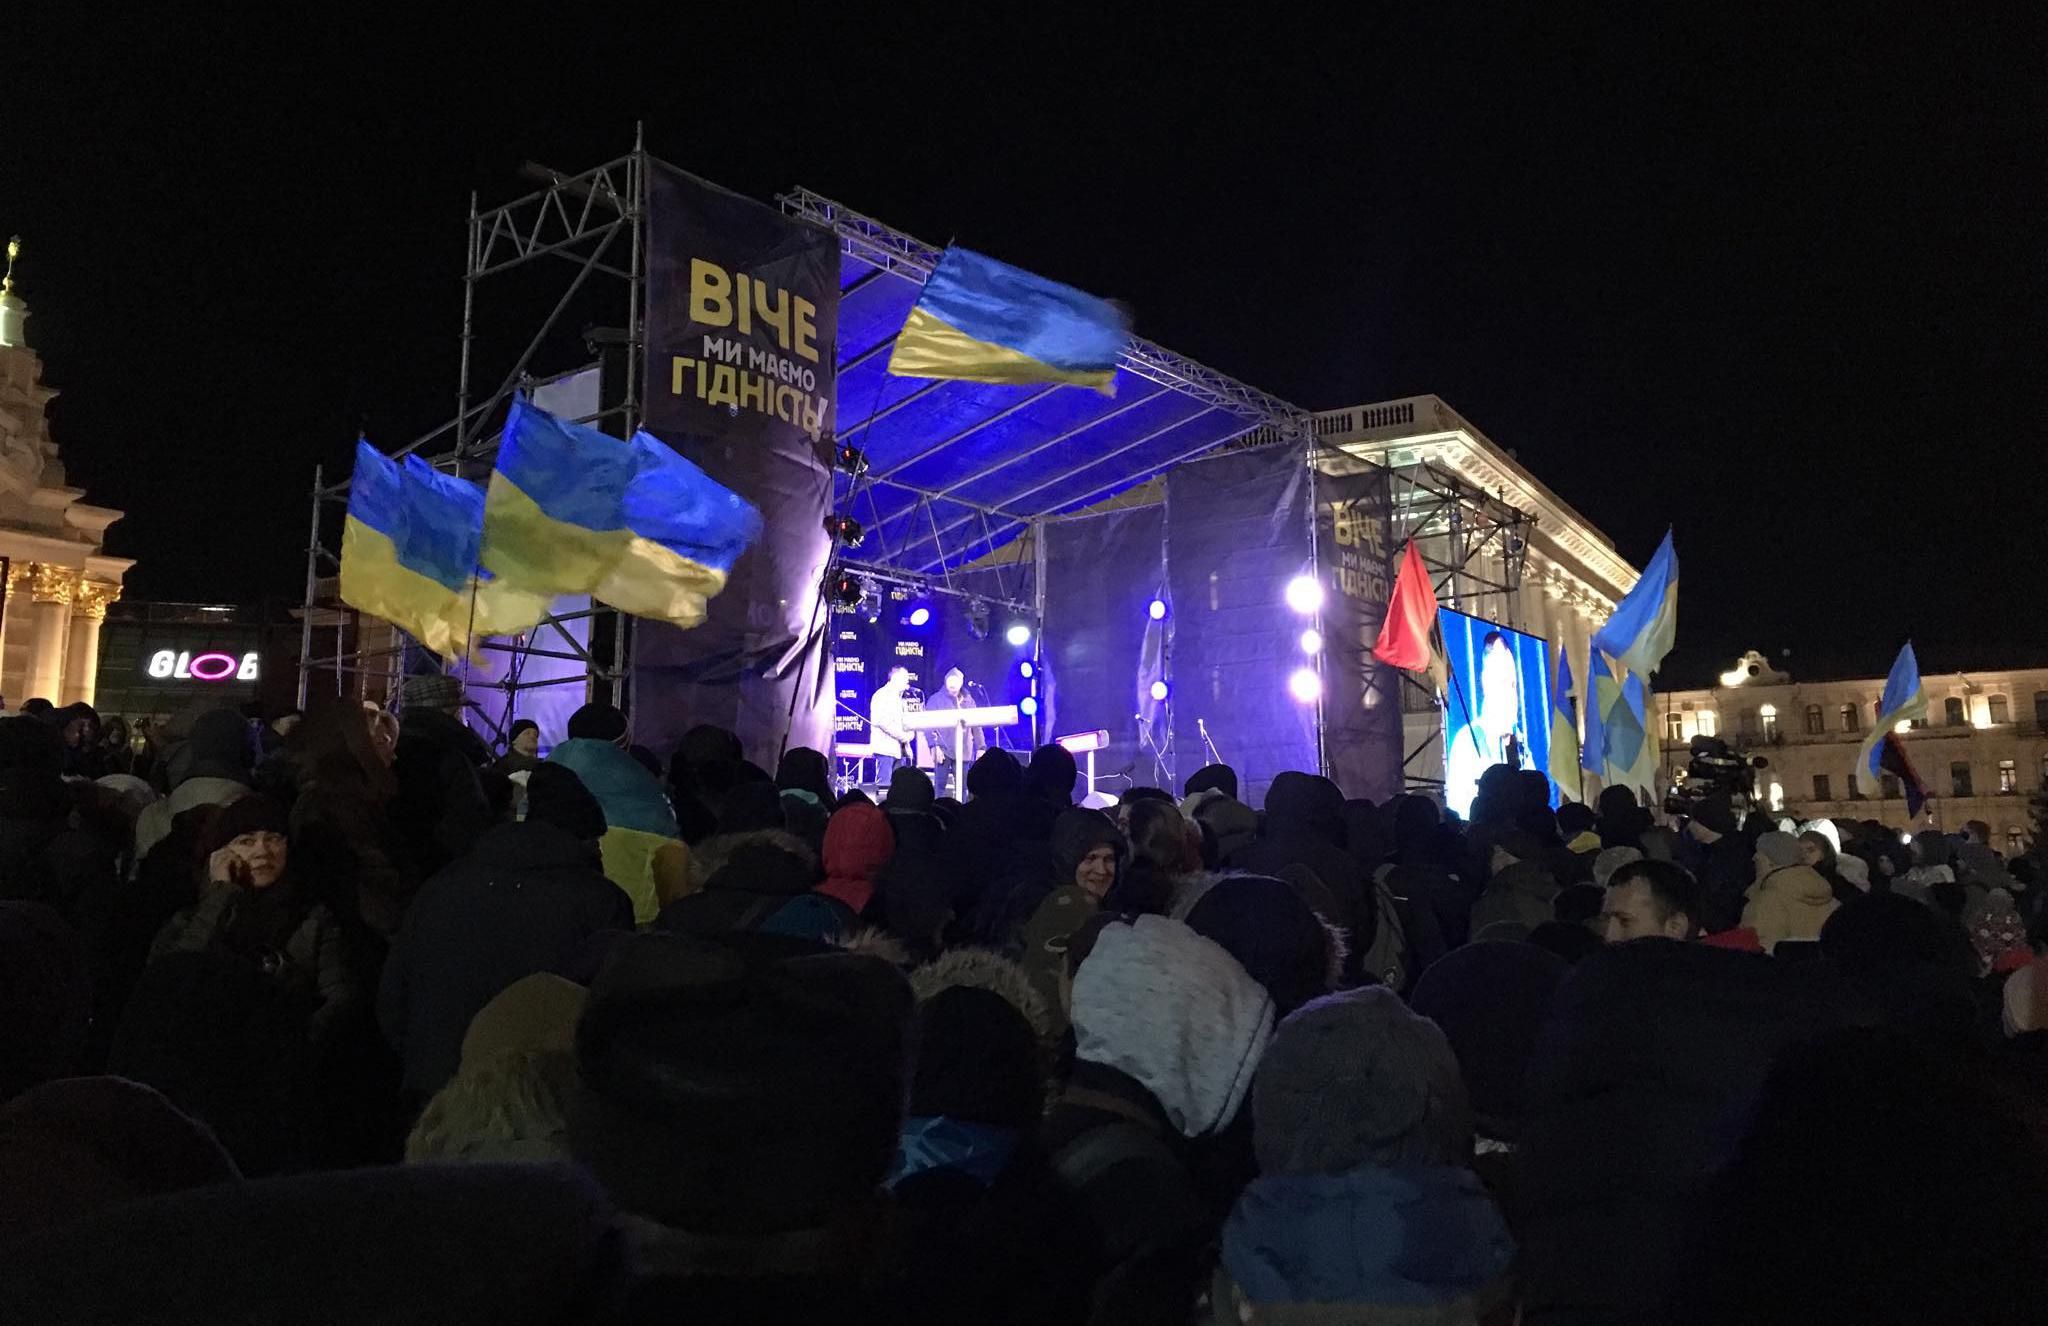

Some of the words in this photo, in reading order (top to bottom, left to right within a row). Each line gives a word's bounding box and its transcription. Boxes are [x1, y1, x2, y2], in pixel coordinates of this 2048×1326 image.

[690, 257, 819, 364] ВІЧЕ
[703, 335, 742, 366] МИ
[749, 347, 815, 392] МАЄМО
